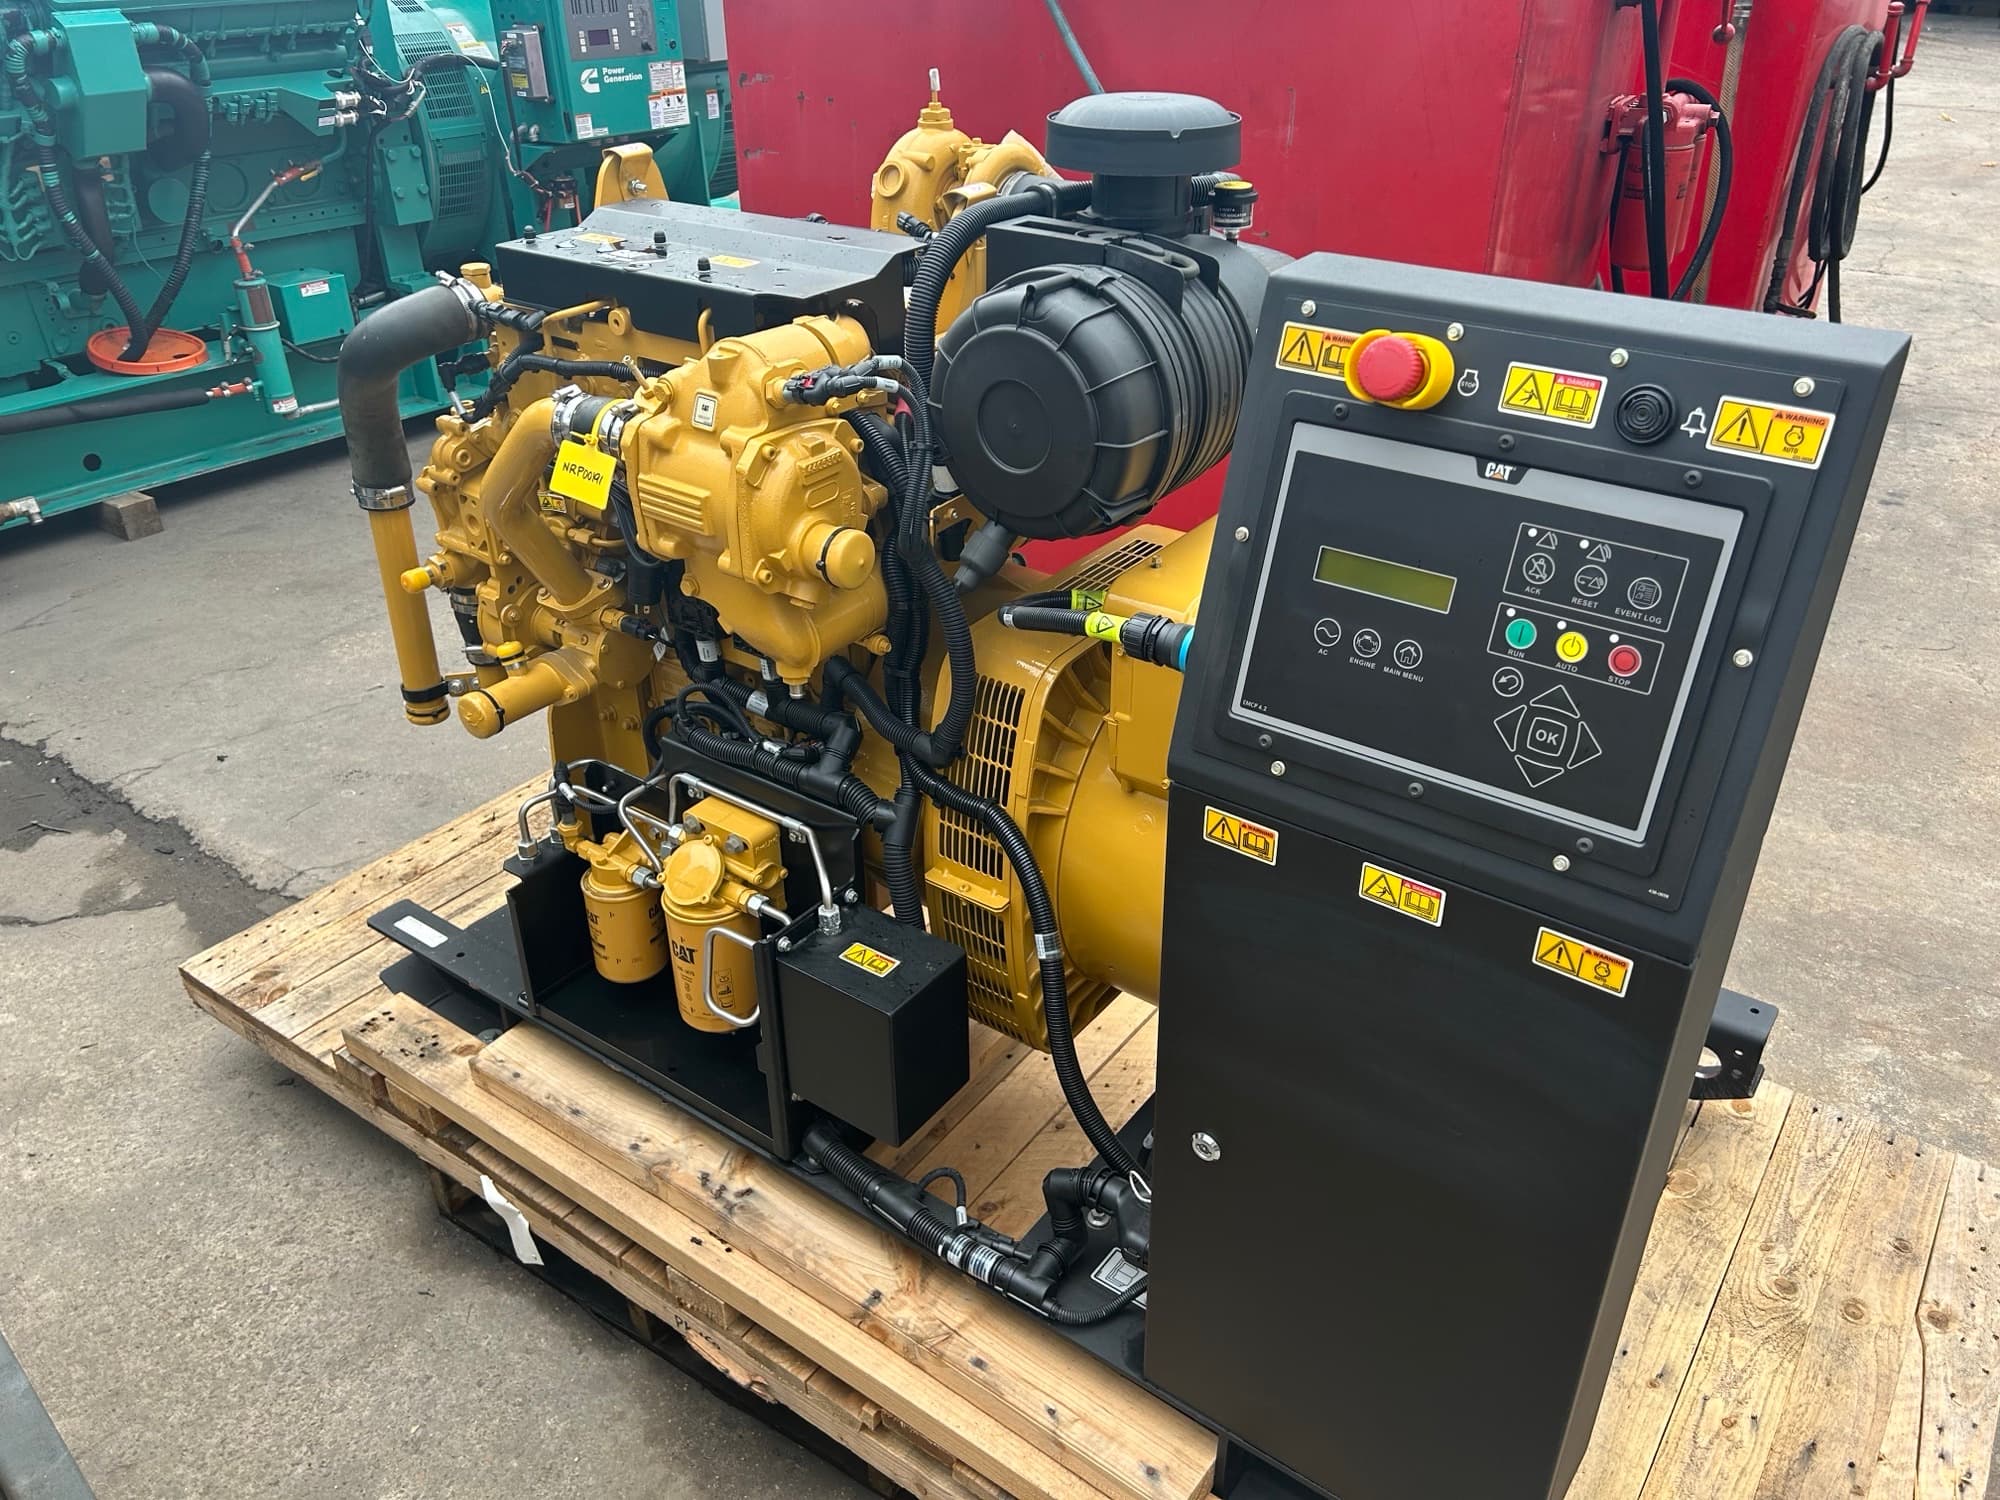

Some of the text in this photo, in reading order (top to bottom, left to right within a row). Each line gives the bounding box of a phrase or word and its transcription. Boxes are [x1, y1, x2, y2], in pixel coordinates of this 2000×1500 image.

[602, 67, 625, 75] Power
[604, 73, 643, 84] Generation
[1567, 378, 1595, 389] DANGER
[1785, 413, 1826, 426] WARNING
[1783, 446, 1799, 454] AUTO
[1485, 462, 1513, 480] CAT
[1524, 585, 1542, 595] ACK
[1571, 597, 1599, 609] RESET
[1614, 607, 1662, 625] EVENT LOG
[1318, 648, 1329, 656] AC
[1507, 649, 1526, 659] RUN
[1349, 656, 1376, 670] ENGINE
[1555, 662, 1578, 673] AUTO
[1383, 666, 1424, 683] MAIN MENU
[1608, 675, 1631, 687] STOP
[1535, 729, 1560, 746] OK
[671, 940, 699, 965] CAT
[1593, 950, 1627, 967] WARNING
